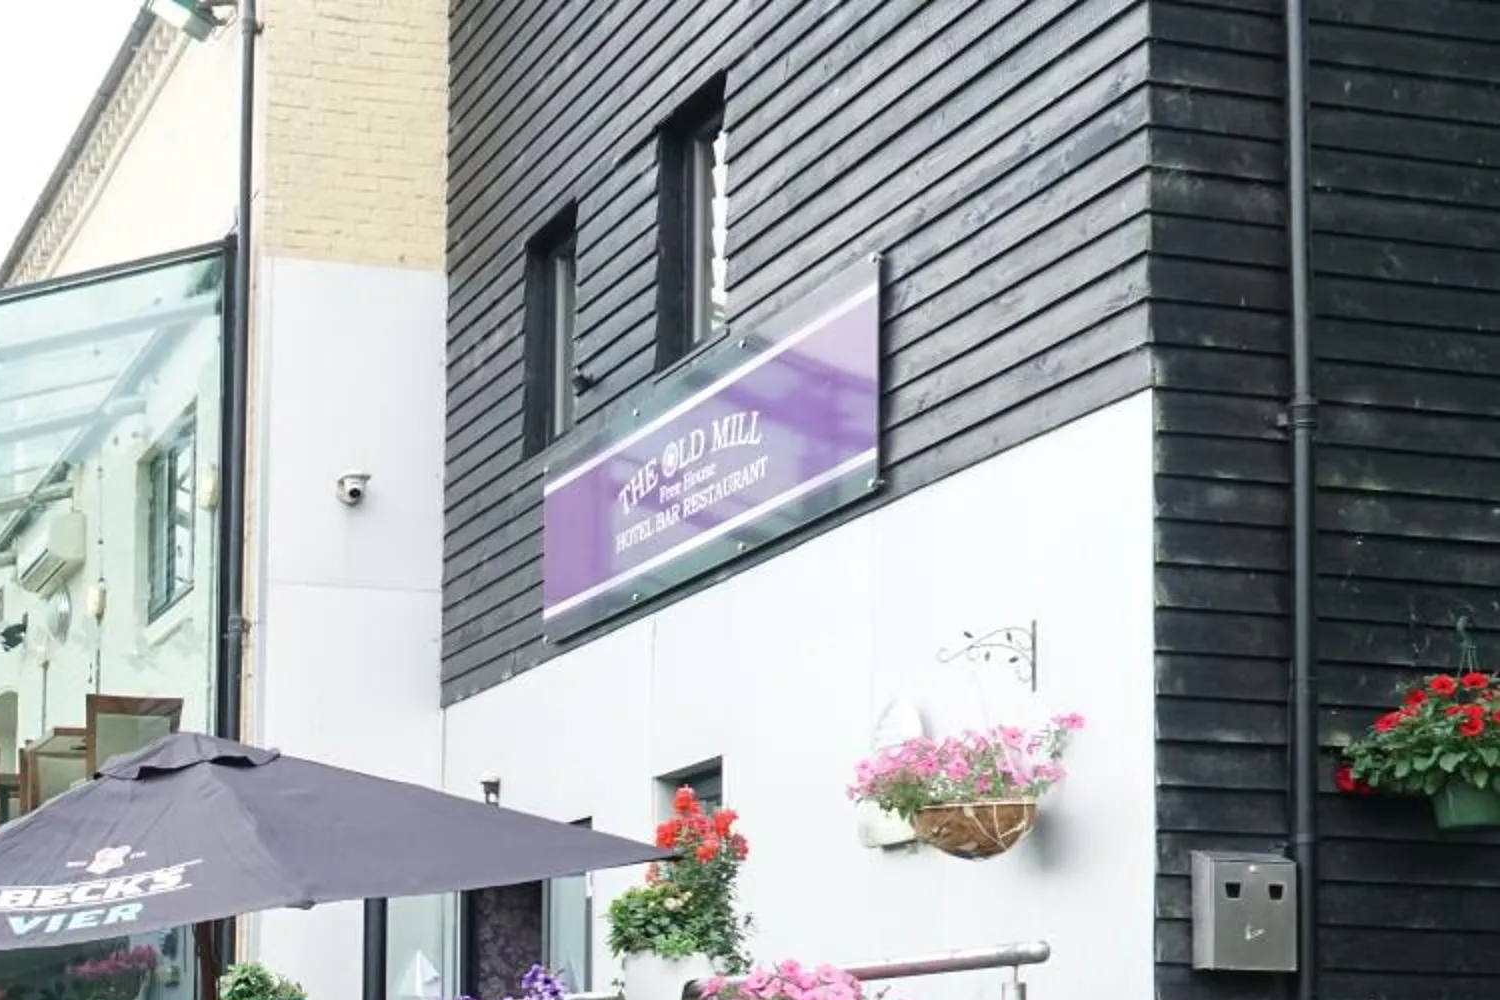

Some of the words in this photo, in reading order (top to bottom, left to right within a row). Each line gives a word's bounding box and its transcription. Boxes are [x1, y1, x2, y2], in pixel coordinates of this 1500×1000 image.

[615, 518, 656, 553] HOTEL
[655, 504, 681, 533] BAR
[683, 456, 768, 518] RESTAURANT
[618, 458, 659, 515] THE
[662, 429, 705, 478] OLD
[711, 411, 763, 452] MILL
[7, 902, 144, 936] VIER
